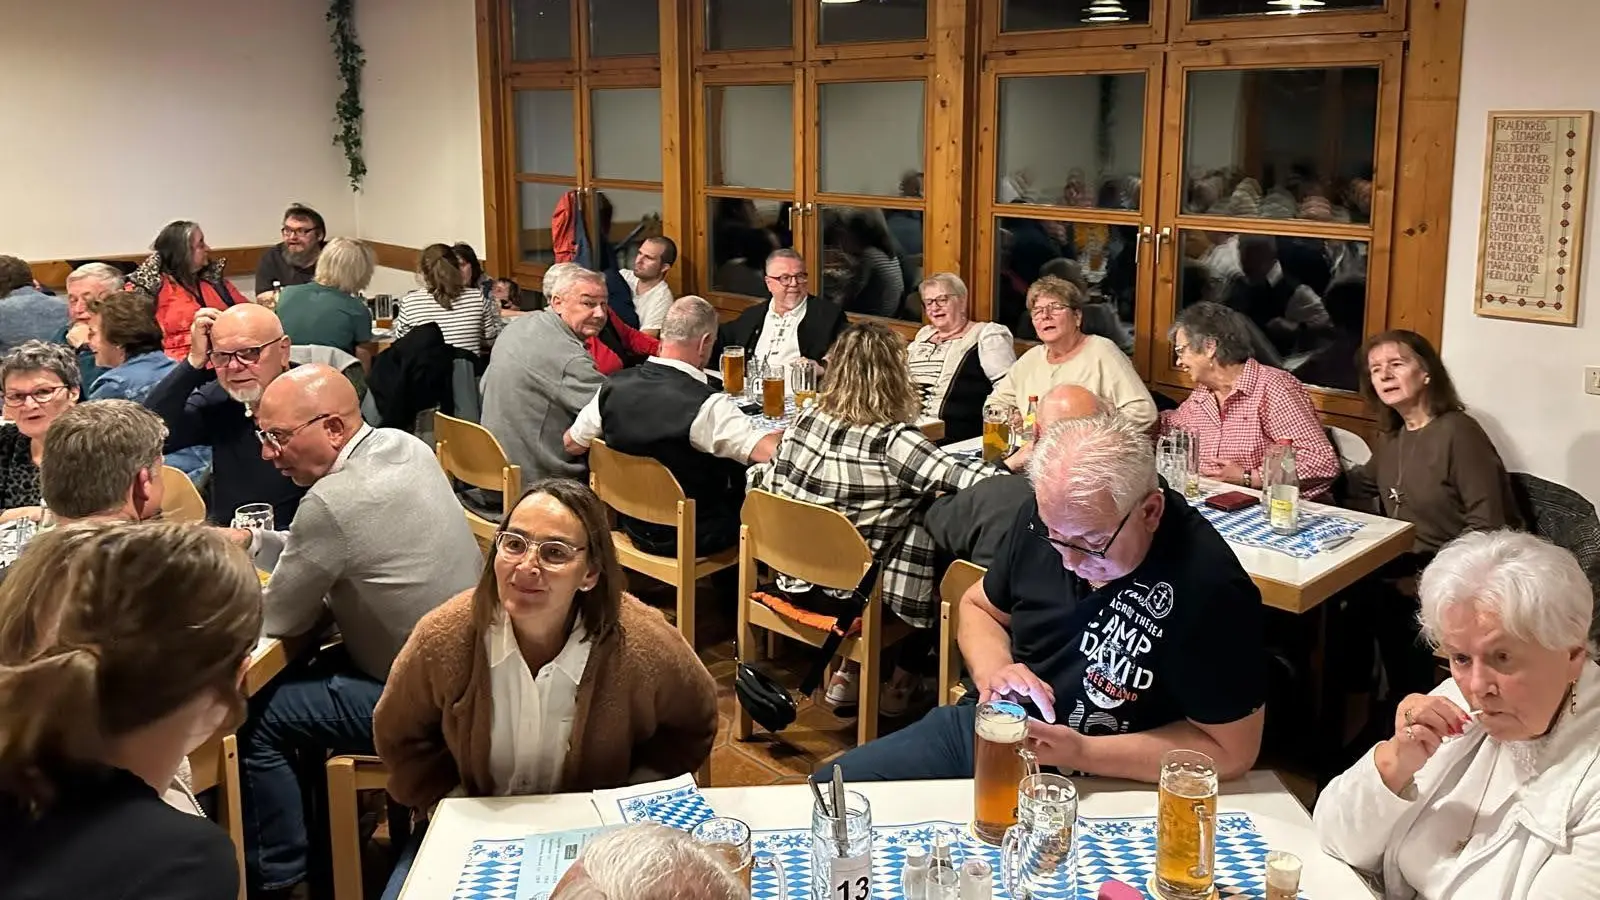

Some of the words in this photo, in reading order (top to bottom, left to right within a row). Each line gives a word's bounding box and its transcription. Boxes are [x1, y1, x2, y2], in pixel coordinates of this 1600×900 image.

[1491, 202, 1514, 212] MARIA
[1487, 261, 1511, 270] MARIA
[1079, 631, 1153, 690] DAVID
[836, 876, 869, 900] 13
